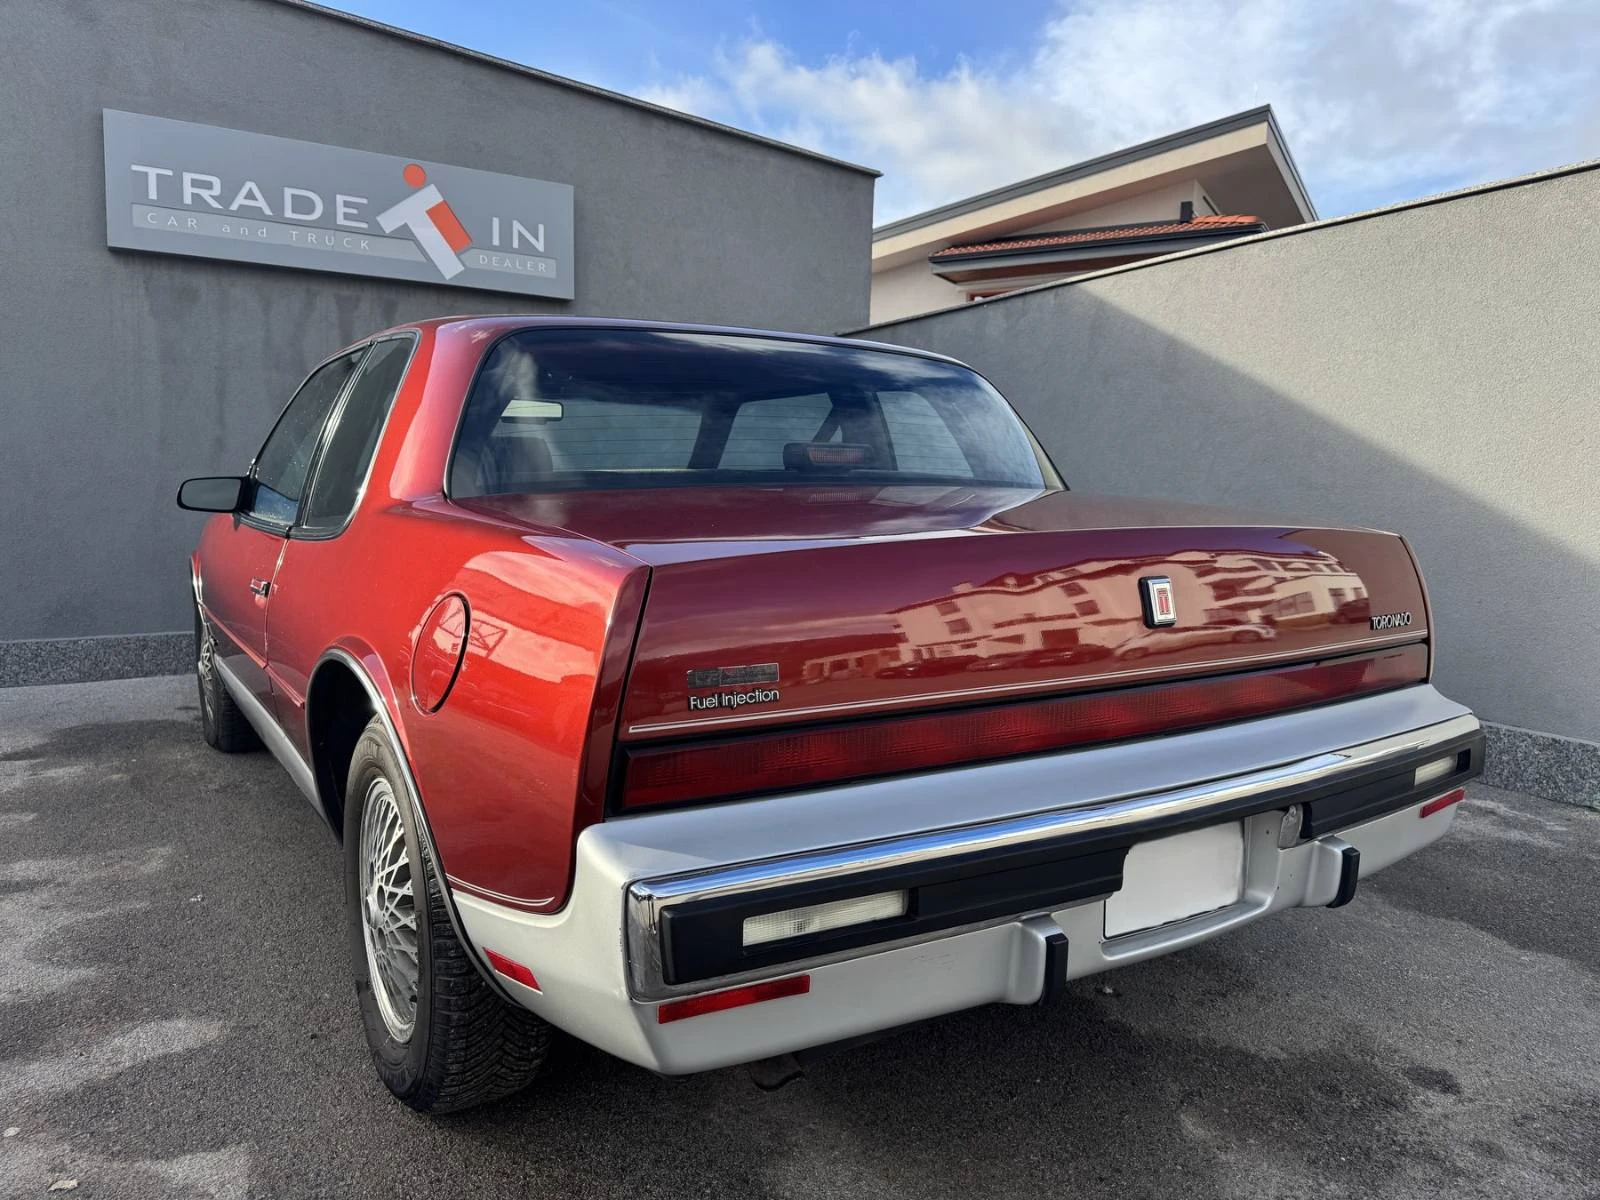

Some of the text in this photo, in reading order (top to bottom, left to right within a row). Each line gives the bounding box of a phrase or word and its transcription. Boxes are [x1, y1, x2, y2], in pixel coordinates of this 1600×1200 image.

[131, 164, 368, 228] TRADE
[492, 217, 545, 252] IN
[147, 212, 546, 273] CAR and TRUCK DEALER
[1371, 611, 1412, 630] TORONADO
[690, 689, 780, 710] Fuel Injection
